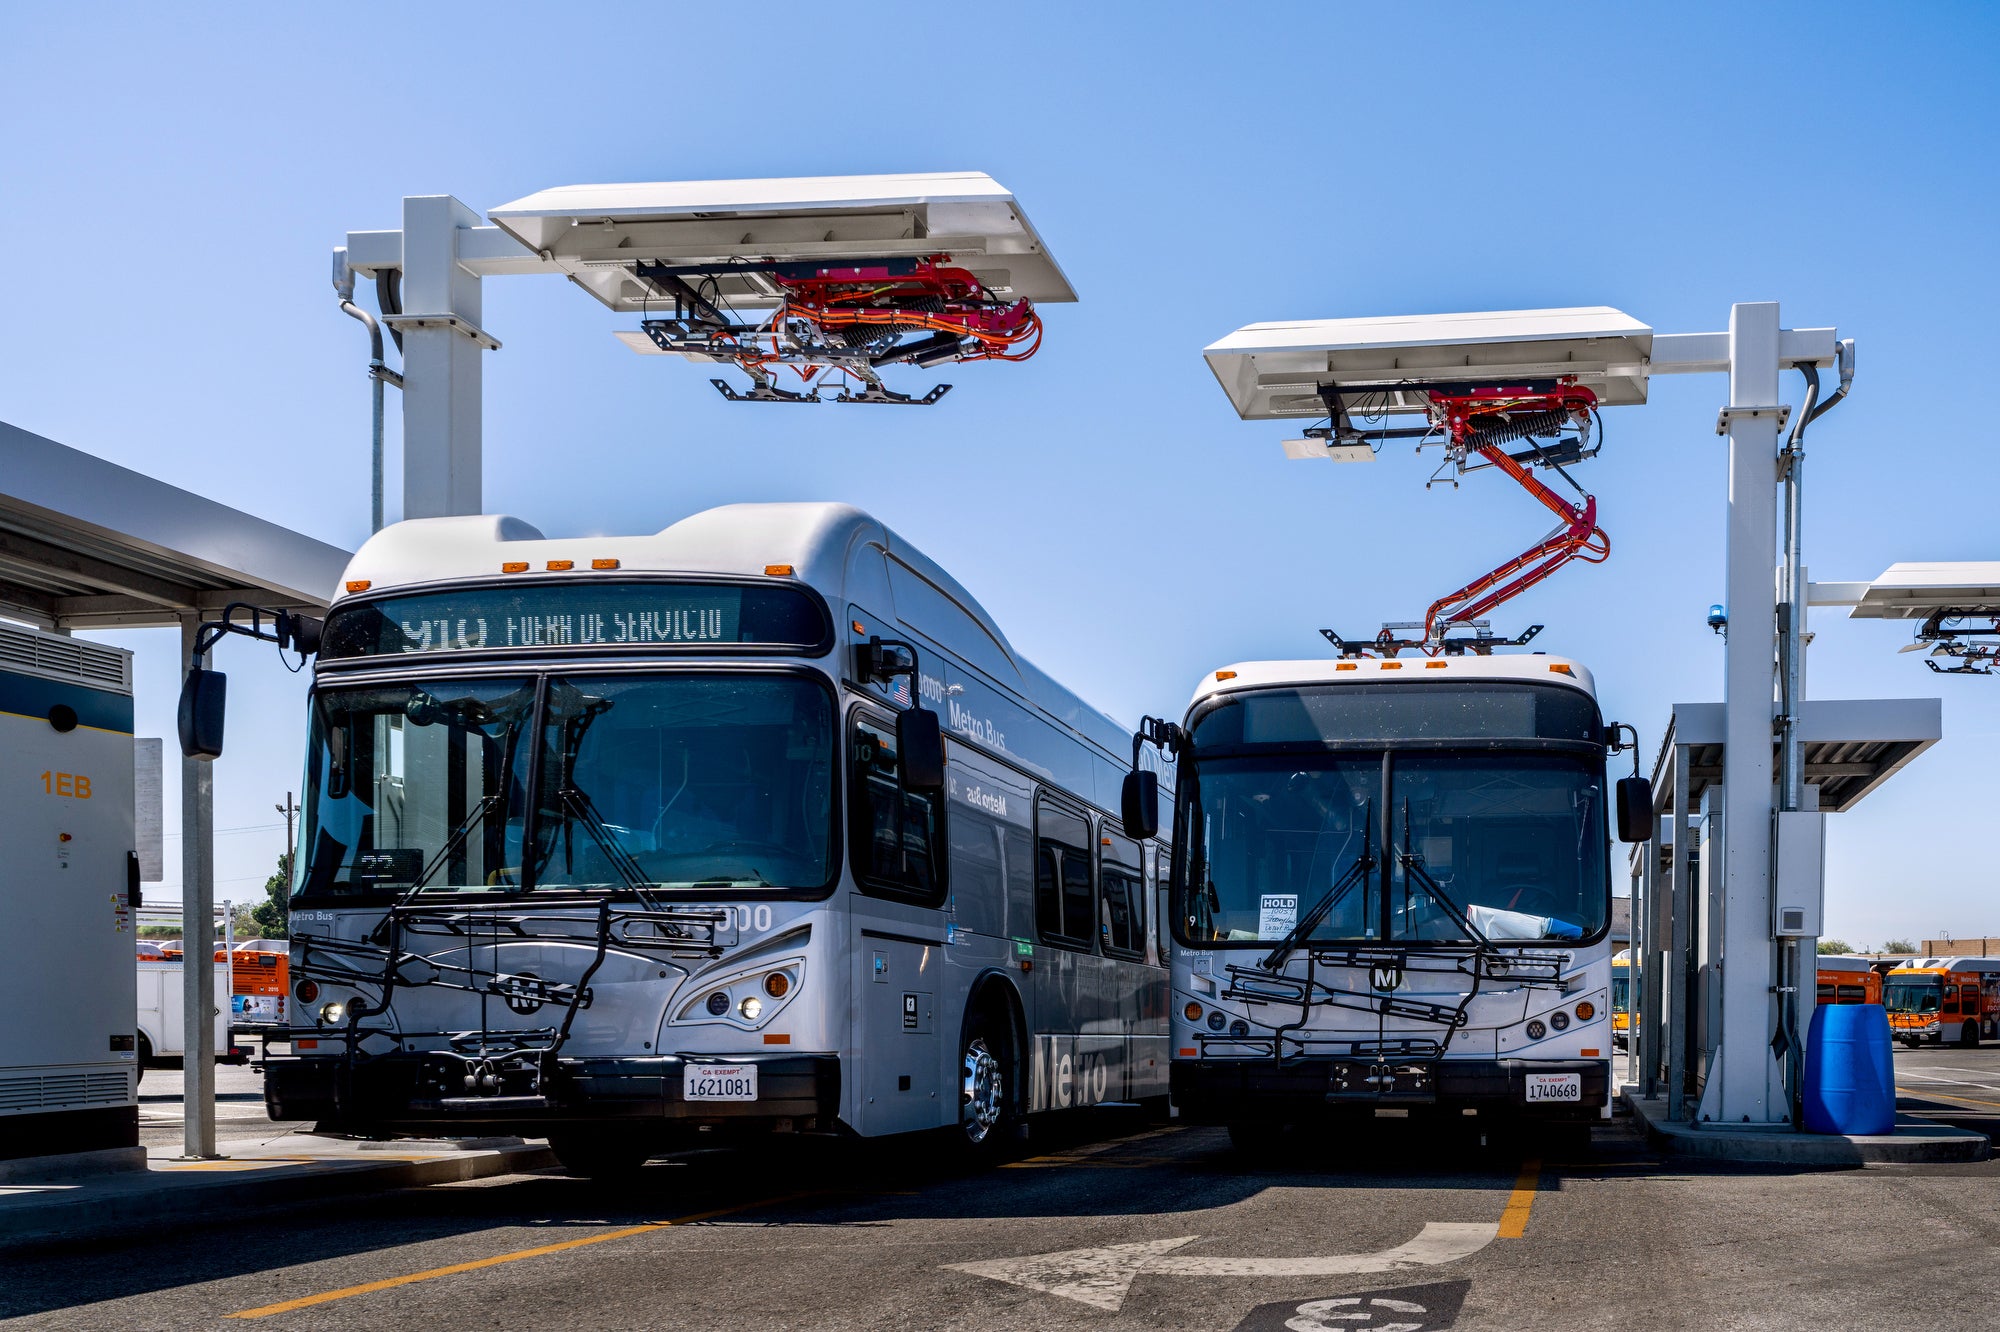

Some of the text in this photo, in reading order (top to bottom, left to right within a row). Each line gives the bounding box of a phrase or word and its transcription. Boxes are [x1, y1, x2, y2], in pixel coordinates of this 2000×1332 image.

[507, 616, 572, 647] FUERA
[580, 613, 606, 644] DE
[949, 699, 1006, 750] Metro Bus
[41, 770, 92, 799] 1EB
[1263, 899, 1295, 908] HOLD
[316, 911, 333, 921] Bus
[1189, 915, 1196, 927] 9
[1180, 949, 1200, 957] Metro
[1375, 968, 1397, 987] M
[1033, 1034, 1107, 1112] Metro
[688, 1078, 753, 1096] 1621081
[1529, 1083, 1577, 1099] 1740668
